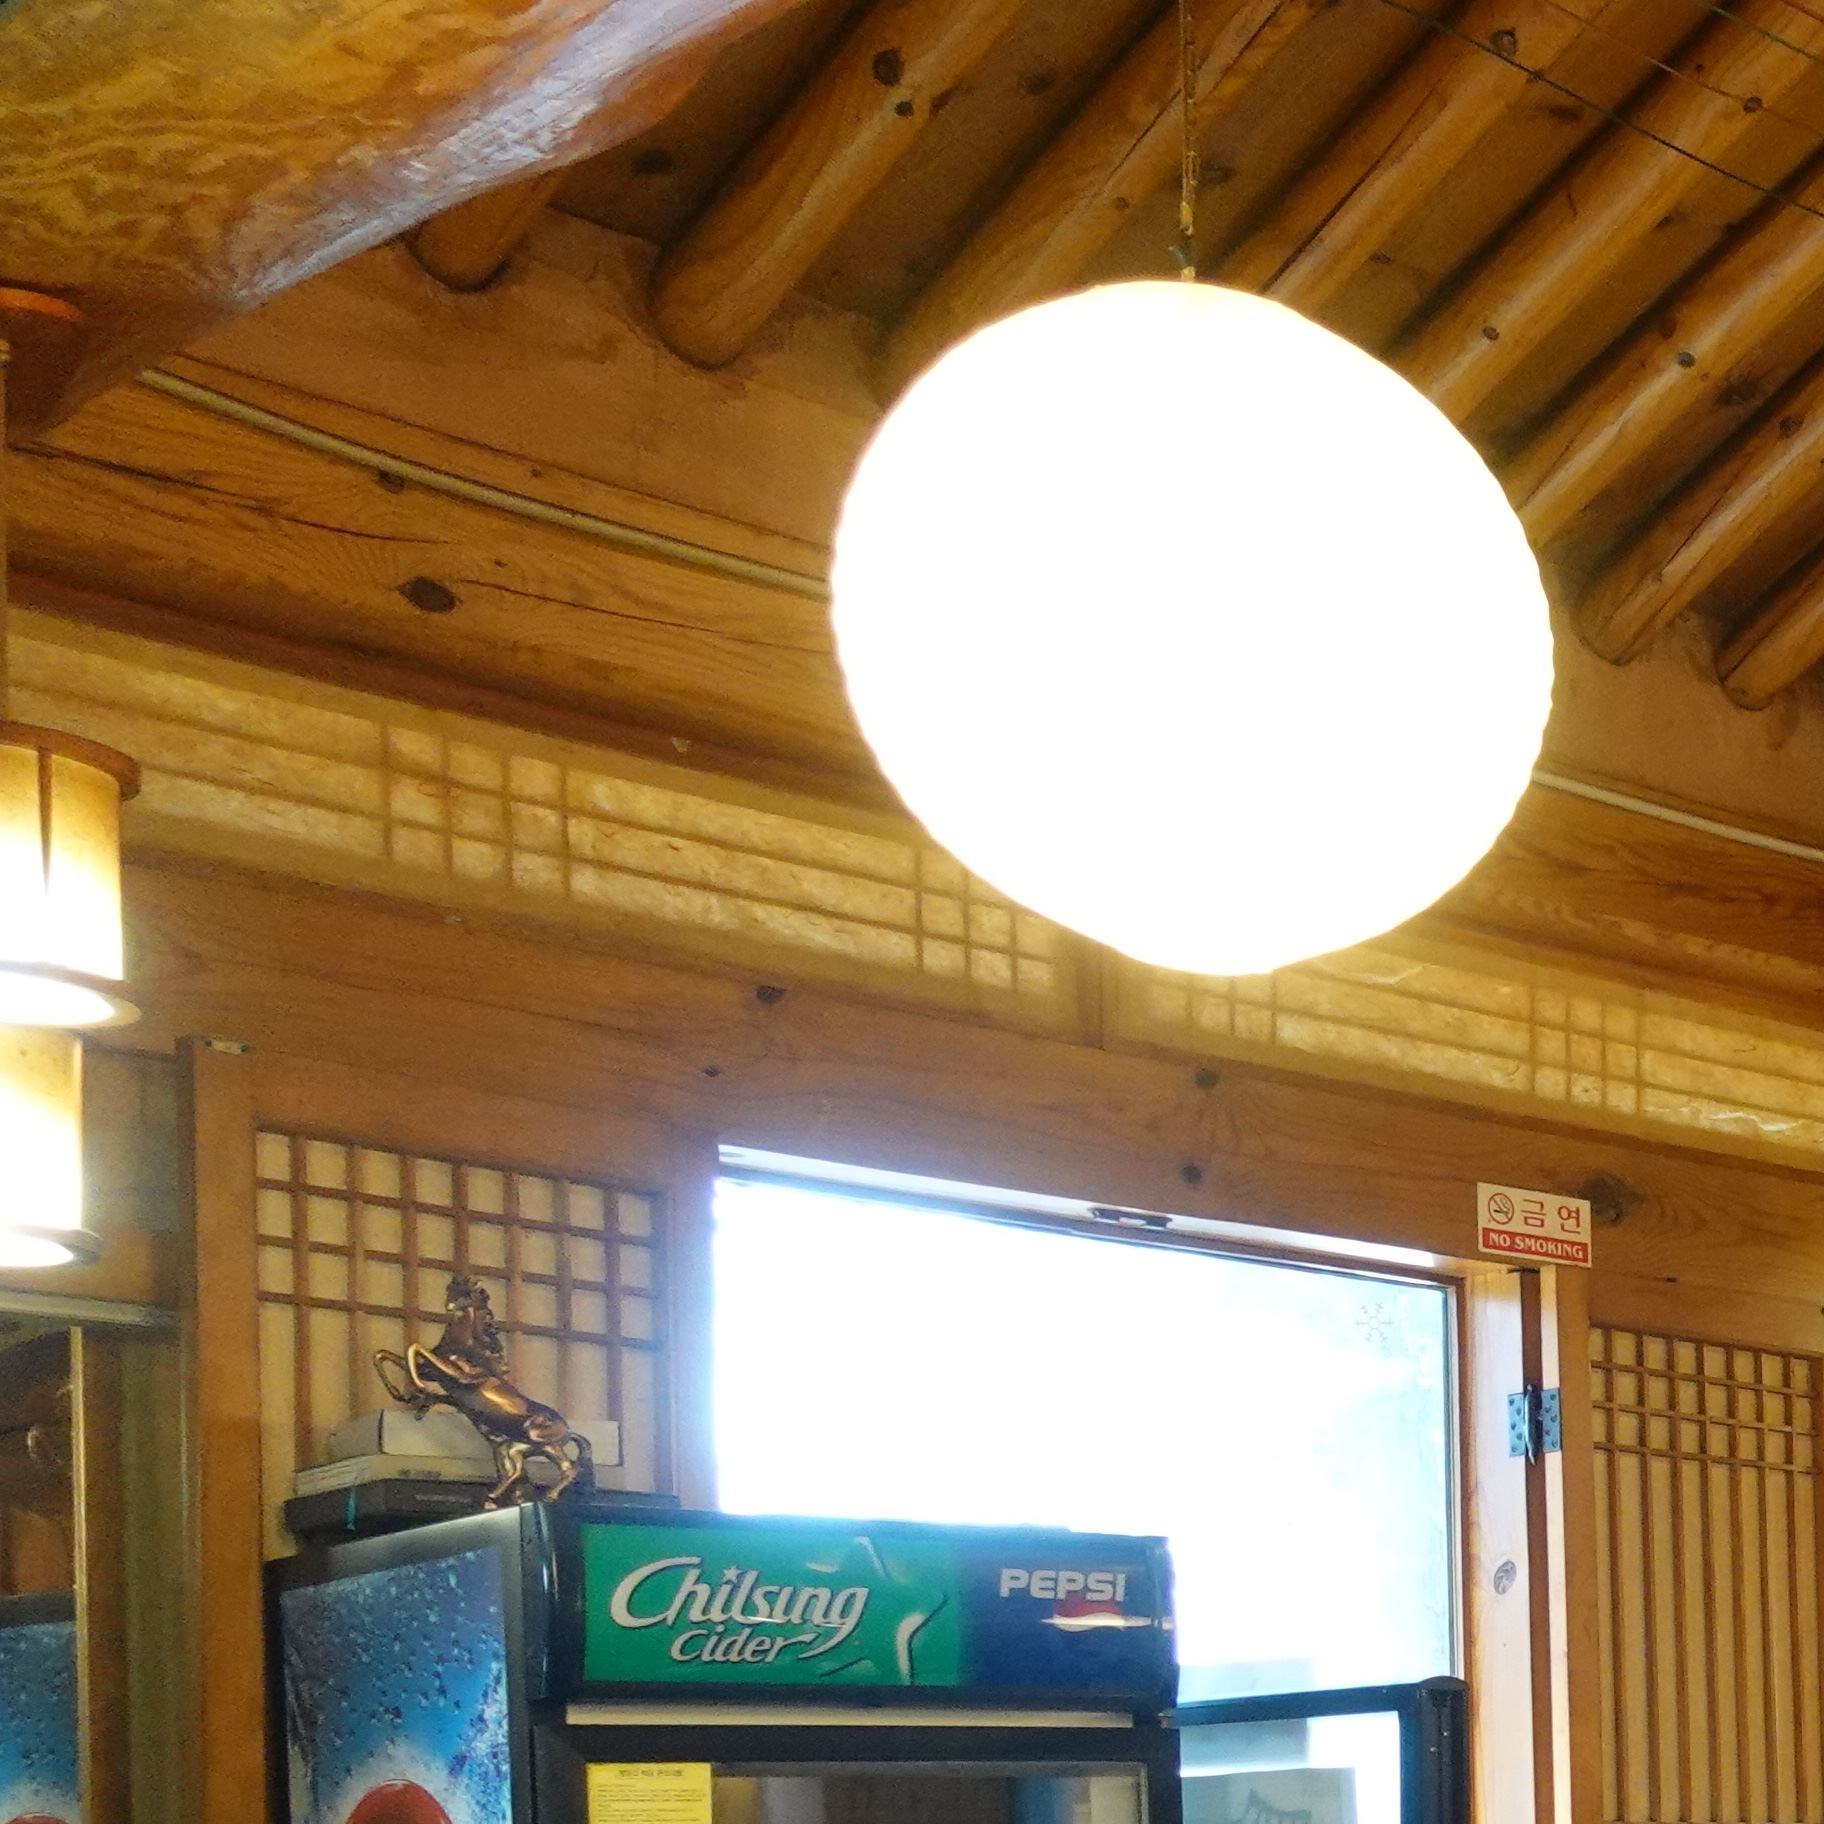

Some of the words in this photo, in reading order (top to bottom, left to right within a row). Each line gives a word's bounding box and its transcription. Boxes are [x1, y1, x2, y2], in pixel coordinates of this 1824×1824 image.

[1521, 1198, 1581, 1235] 금연
[1489, 1231, 1511, 1247] NO
[1514, 1235, 1584, 1260] SMOKING
[1000, 1568, 1127, 1602] PEPSI
[610, 1555, 870, 1661] Chilsung
[670, 1624, 821, 1663] Cider
